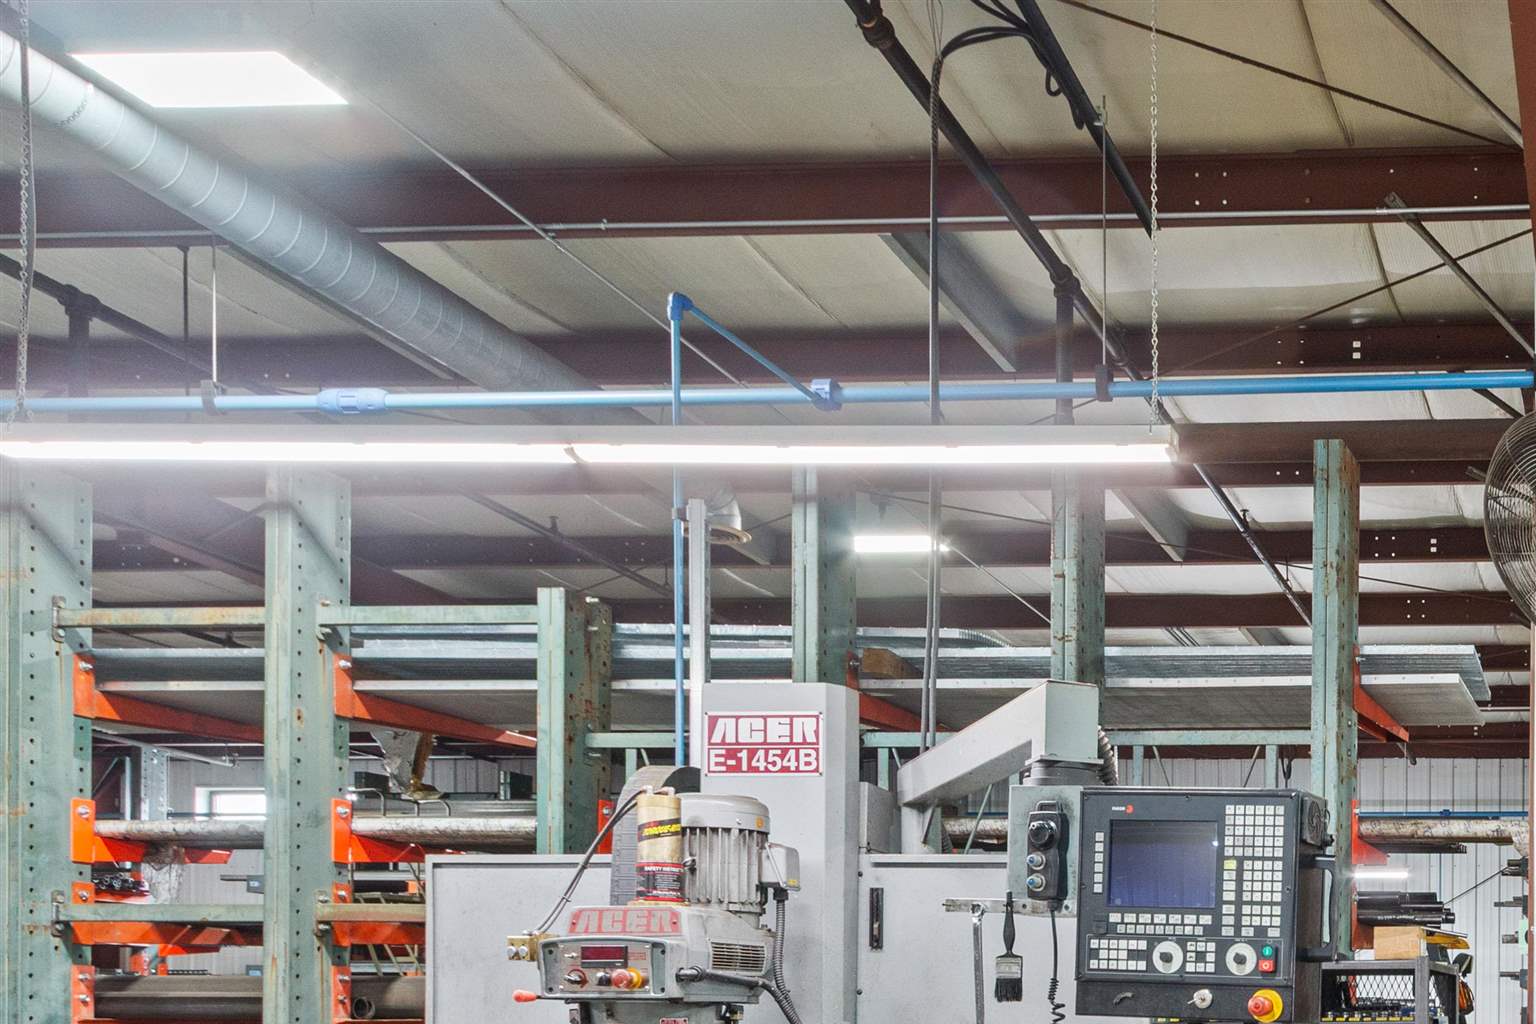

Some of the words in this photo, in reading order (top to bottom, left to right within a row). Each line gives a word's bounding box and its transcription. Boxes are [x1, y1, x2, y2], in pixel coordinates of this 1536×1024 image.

[709, 716, 818, 744] ACER
[708, 748, 818, 772] E-1454B
[574, 910, 673, 933] ACER
